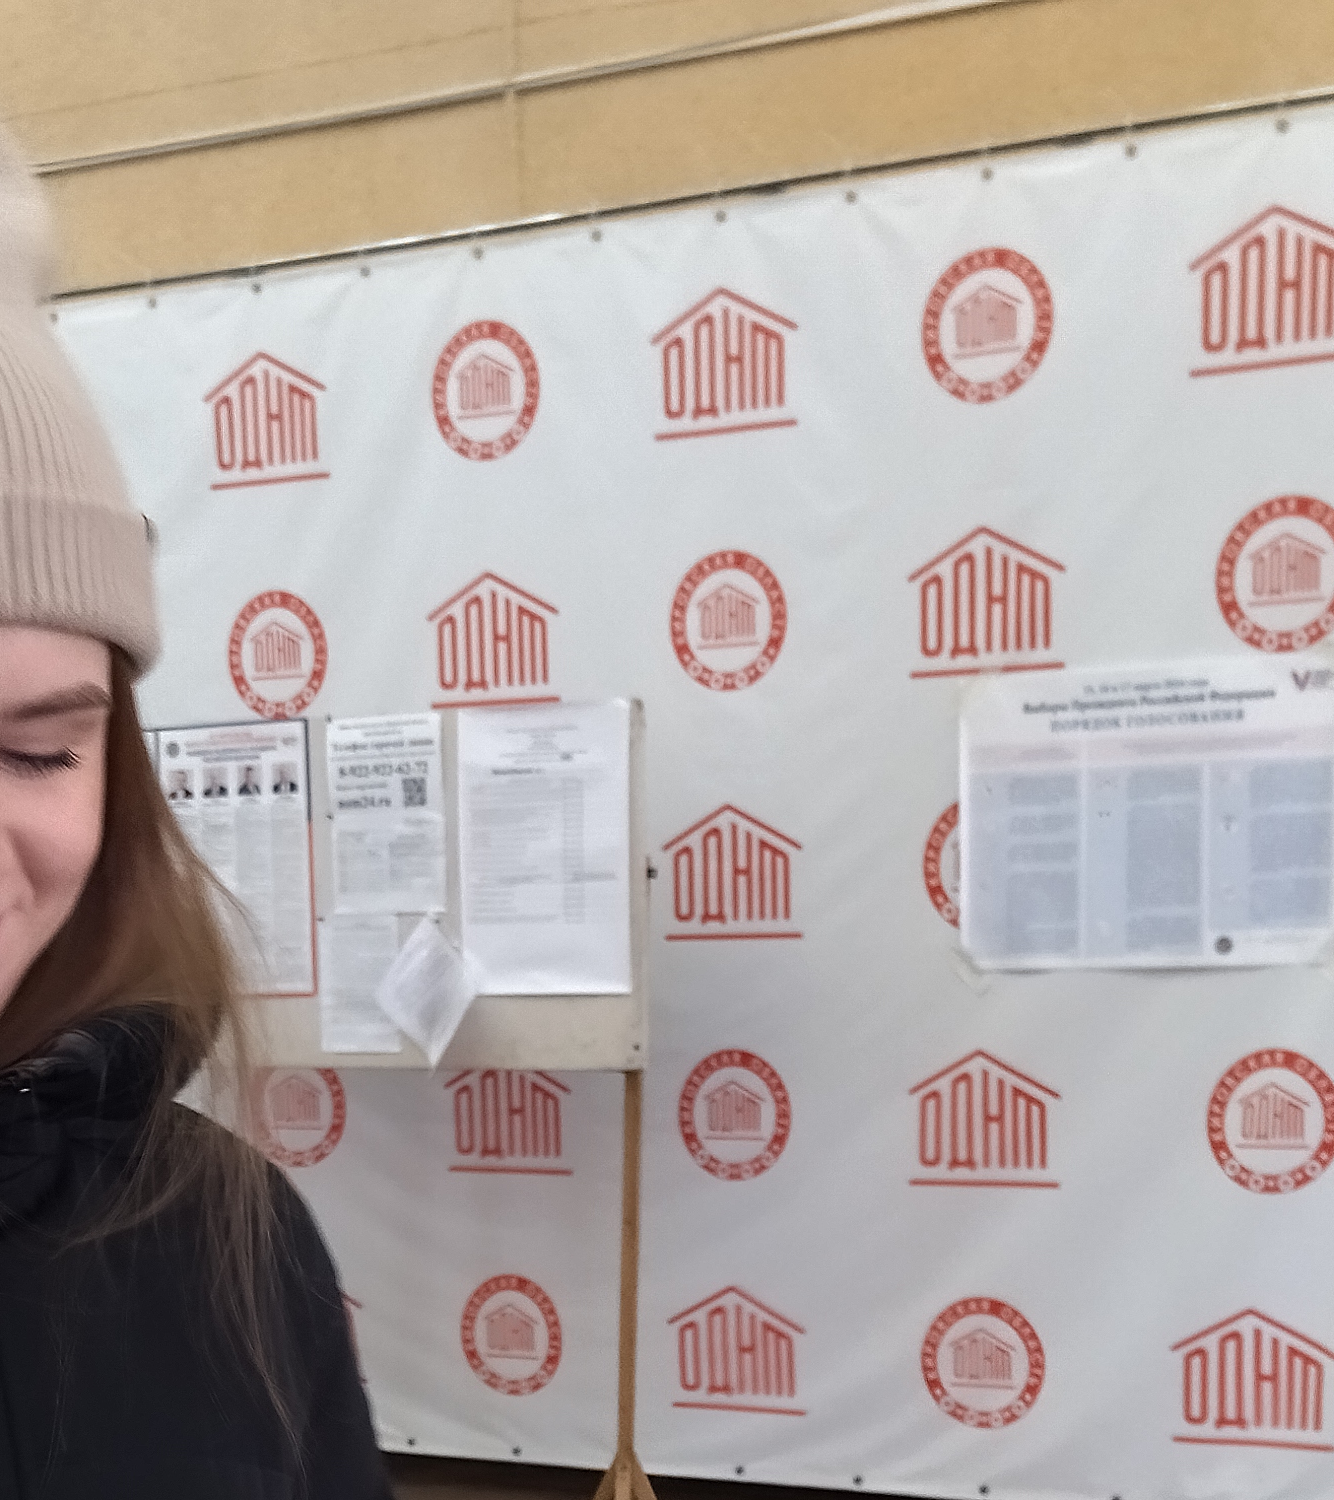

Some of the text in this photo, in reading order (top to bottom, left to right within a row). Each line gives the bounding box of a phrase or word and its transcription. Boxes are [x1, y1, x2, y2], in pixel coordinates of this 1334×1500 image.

[661, 308, 786, 420] ОДНМ
[214, 369, 319, 472] ОДНМ
[437, 590, 549, 692] ОДНМ
[921, 546, 1052, 659] ОДНМ
[673, 822, 792, 925] ОДНМ
[919, 1069, 1047, 1170] ОДНМ
[678, 1304, 795, 1396] ОДНМ
[1183, 1328, 1324, 1431] ОДНМ
